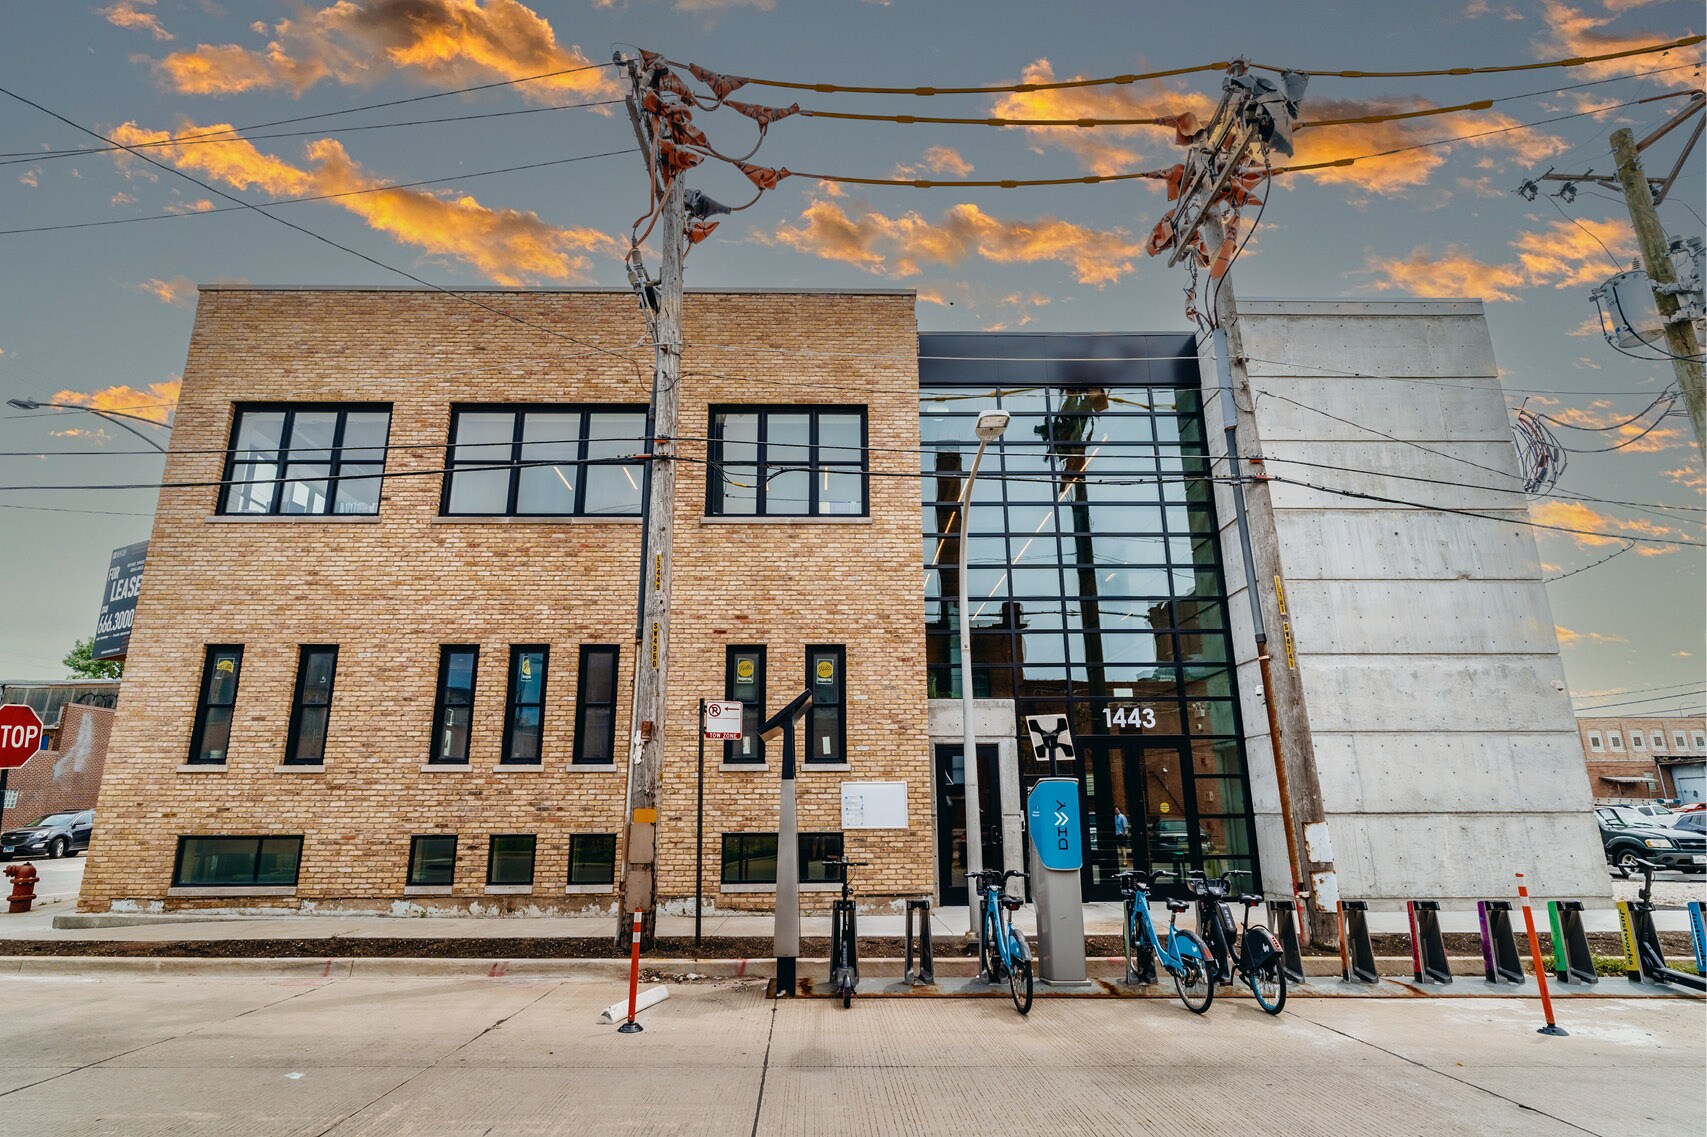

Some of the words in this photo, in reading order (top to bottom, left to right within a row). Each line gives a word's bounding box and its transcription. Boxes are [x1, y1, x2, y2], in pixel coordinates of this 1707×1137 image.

[108, 566, 120, 581] FOR
[110, 575, 143, 602] LEASE
[98, 609, 135, 634] 666.3000
[1102, 707, 1156, 729] 1443
[1, 725, 38, 748] TOP
[1619, 908, 1633, 966] Justworks
[1690, 909, 1706, 967] Justworks
